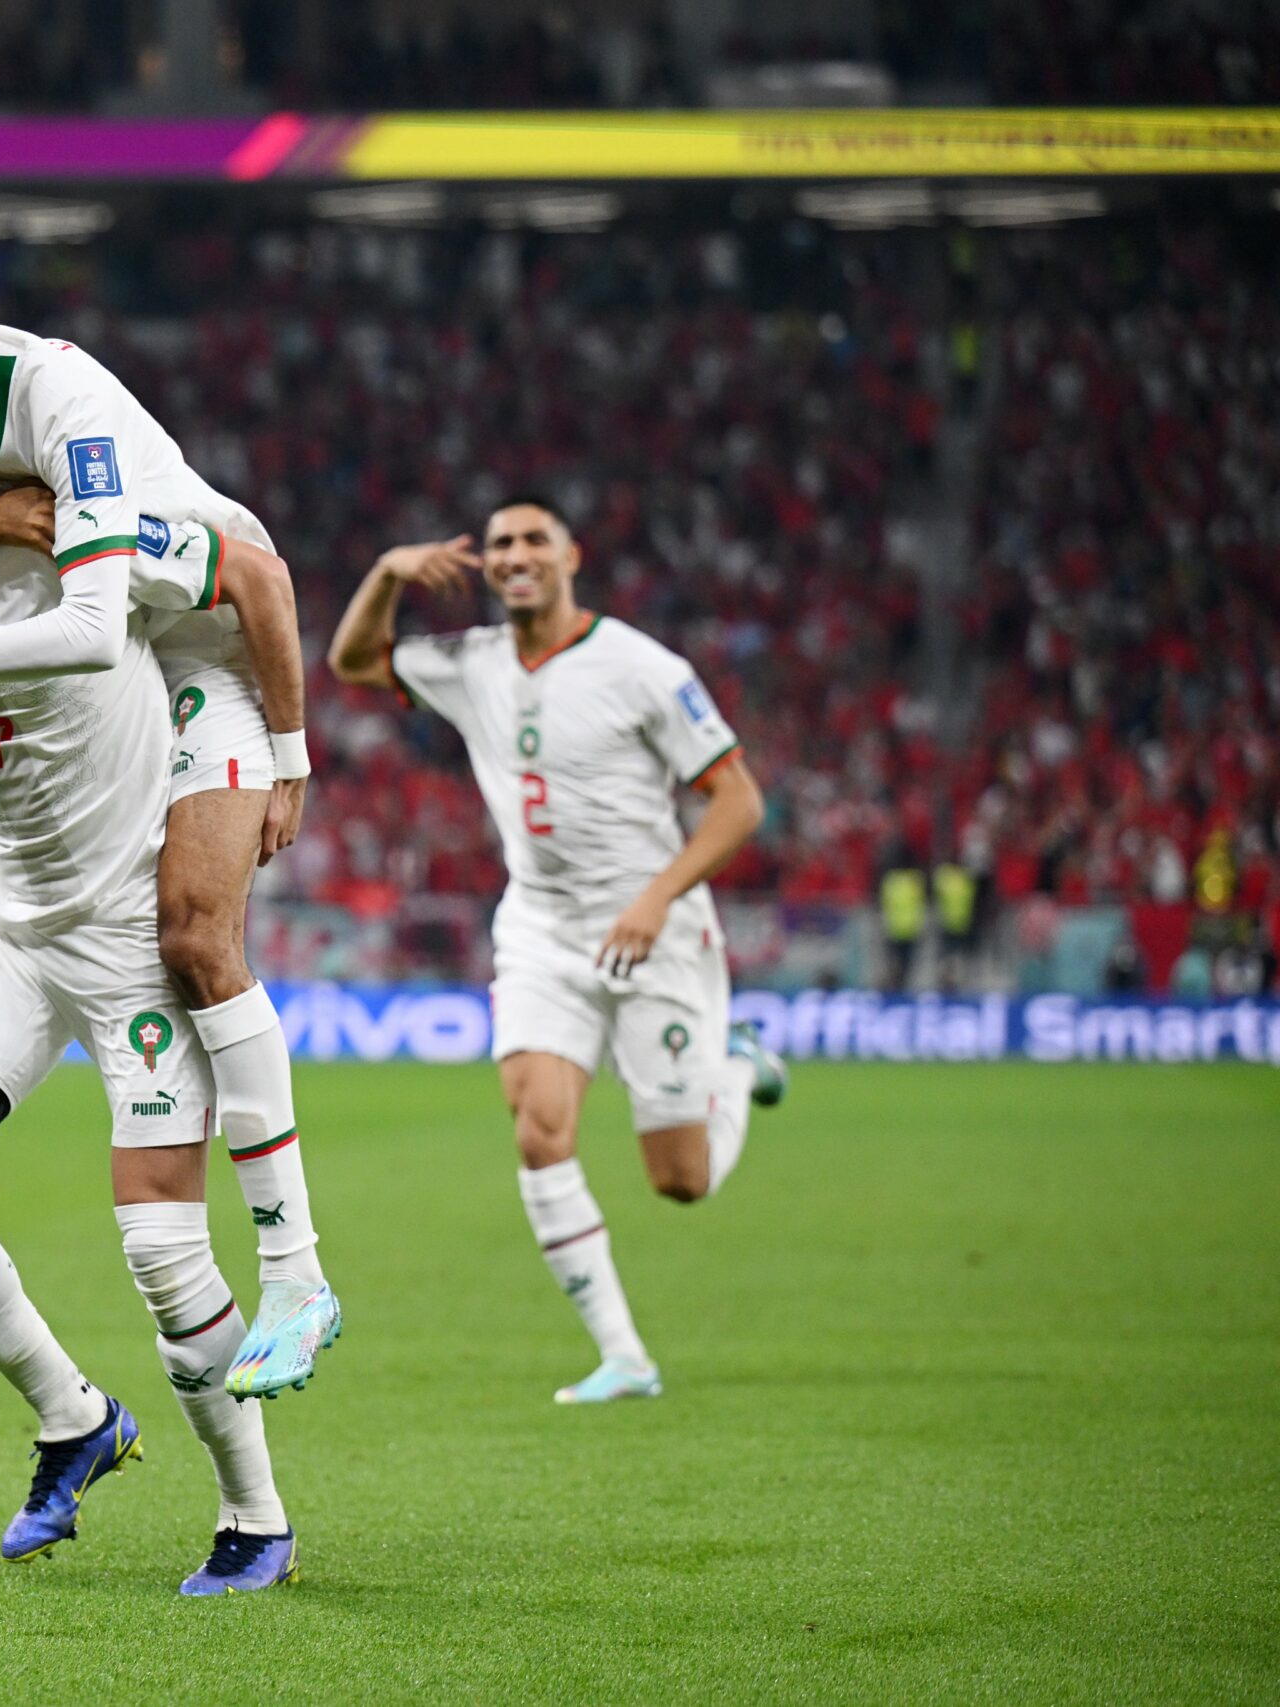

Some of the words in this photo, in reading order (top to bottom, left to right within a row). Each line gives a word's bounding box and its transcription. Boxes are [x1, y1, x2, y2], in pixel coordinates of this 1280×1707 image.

[521, 772, 554, 836] 2
[280, 983, 492, 1063] ivo
[132, 1102, 171, 1116] PUMA
